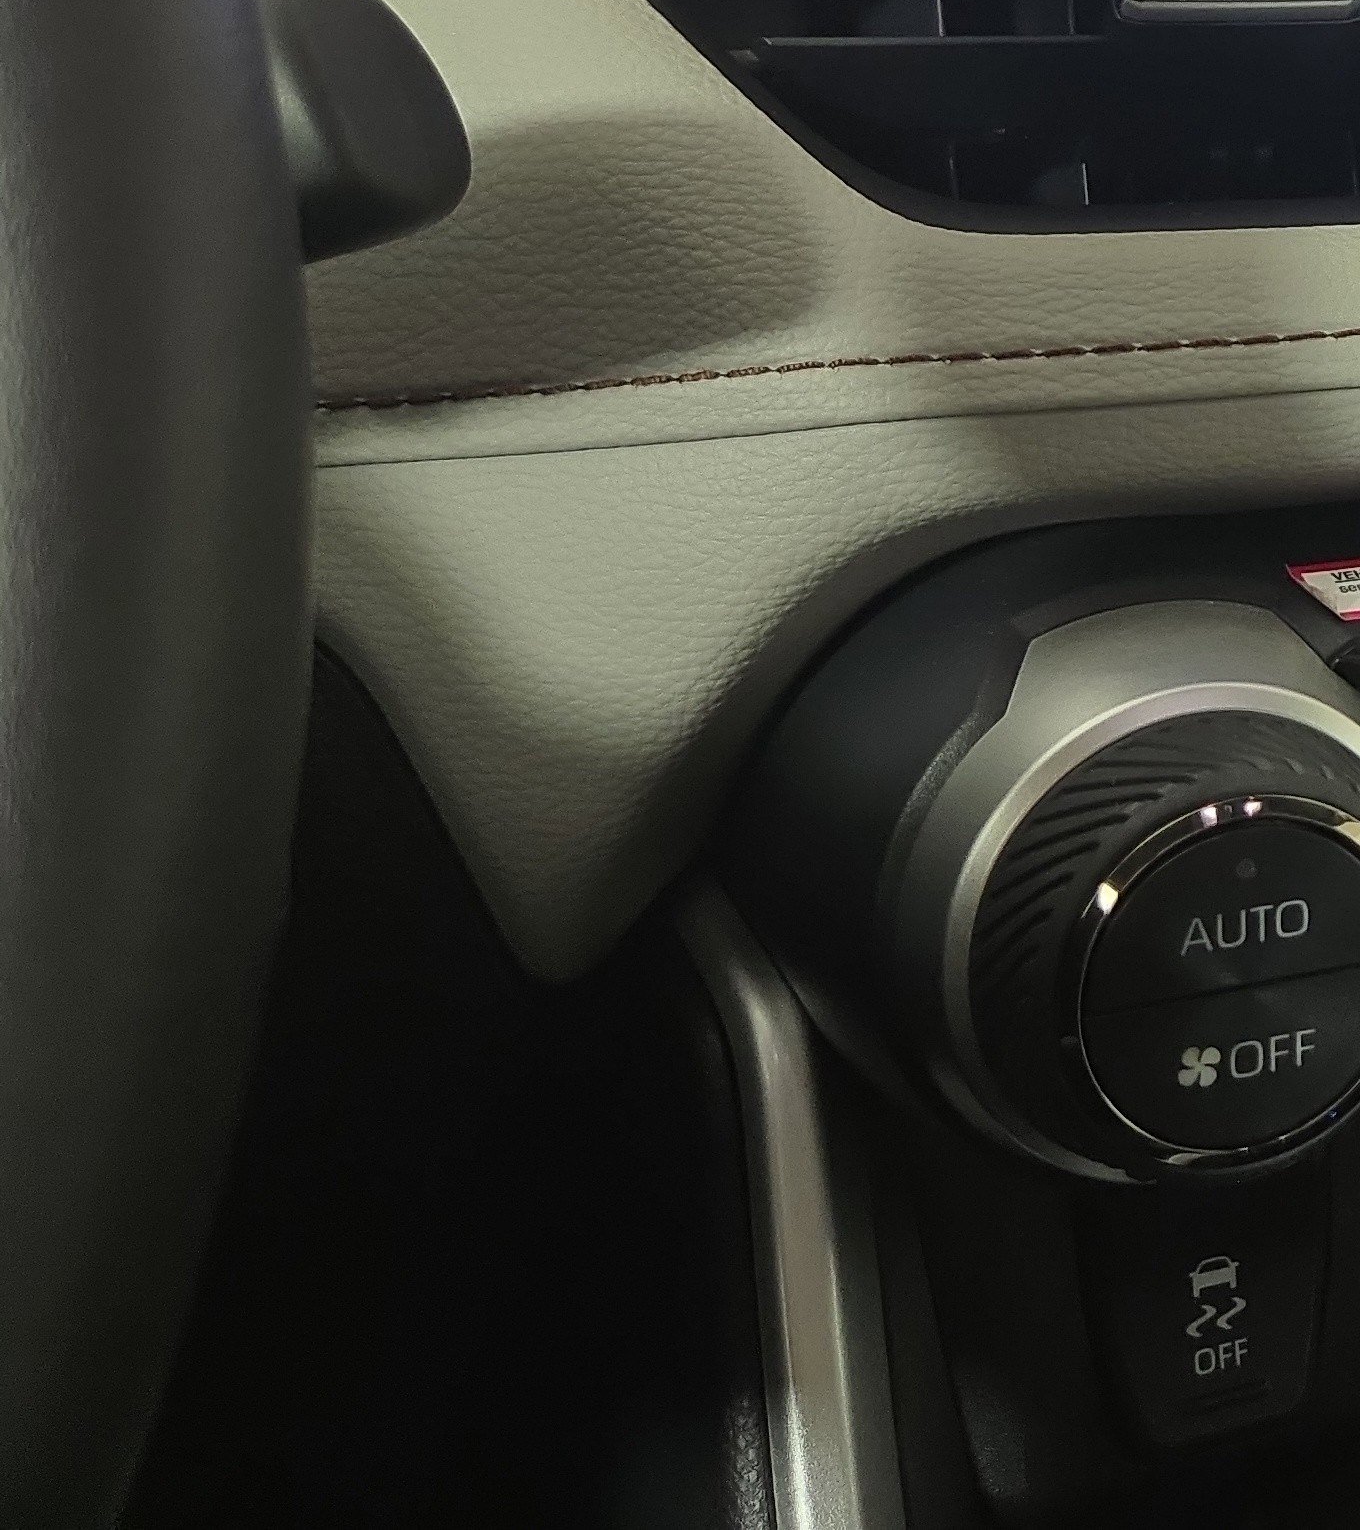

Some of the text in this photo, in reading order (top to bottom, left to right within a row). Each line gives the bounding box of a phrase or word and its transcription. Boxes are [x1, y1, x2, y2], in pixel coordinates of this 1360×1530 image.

[1180, 899, 1310, 957] AUTO
[1230, 1029, 1317, 1079] OFF
[1194, 1338, 1249, 1375] OFF
